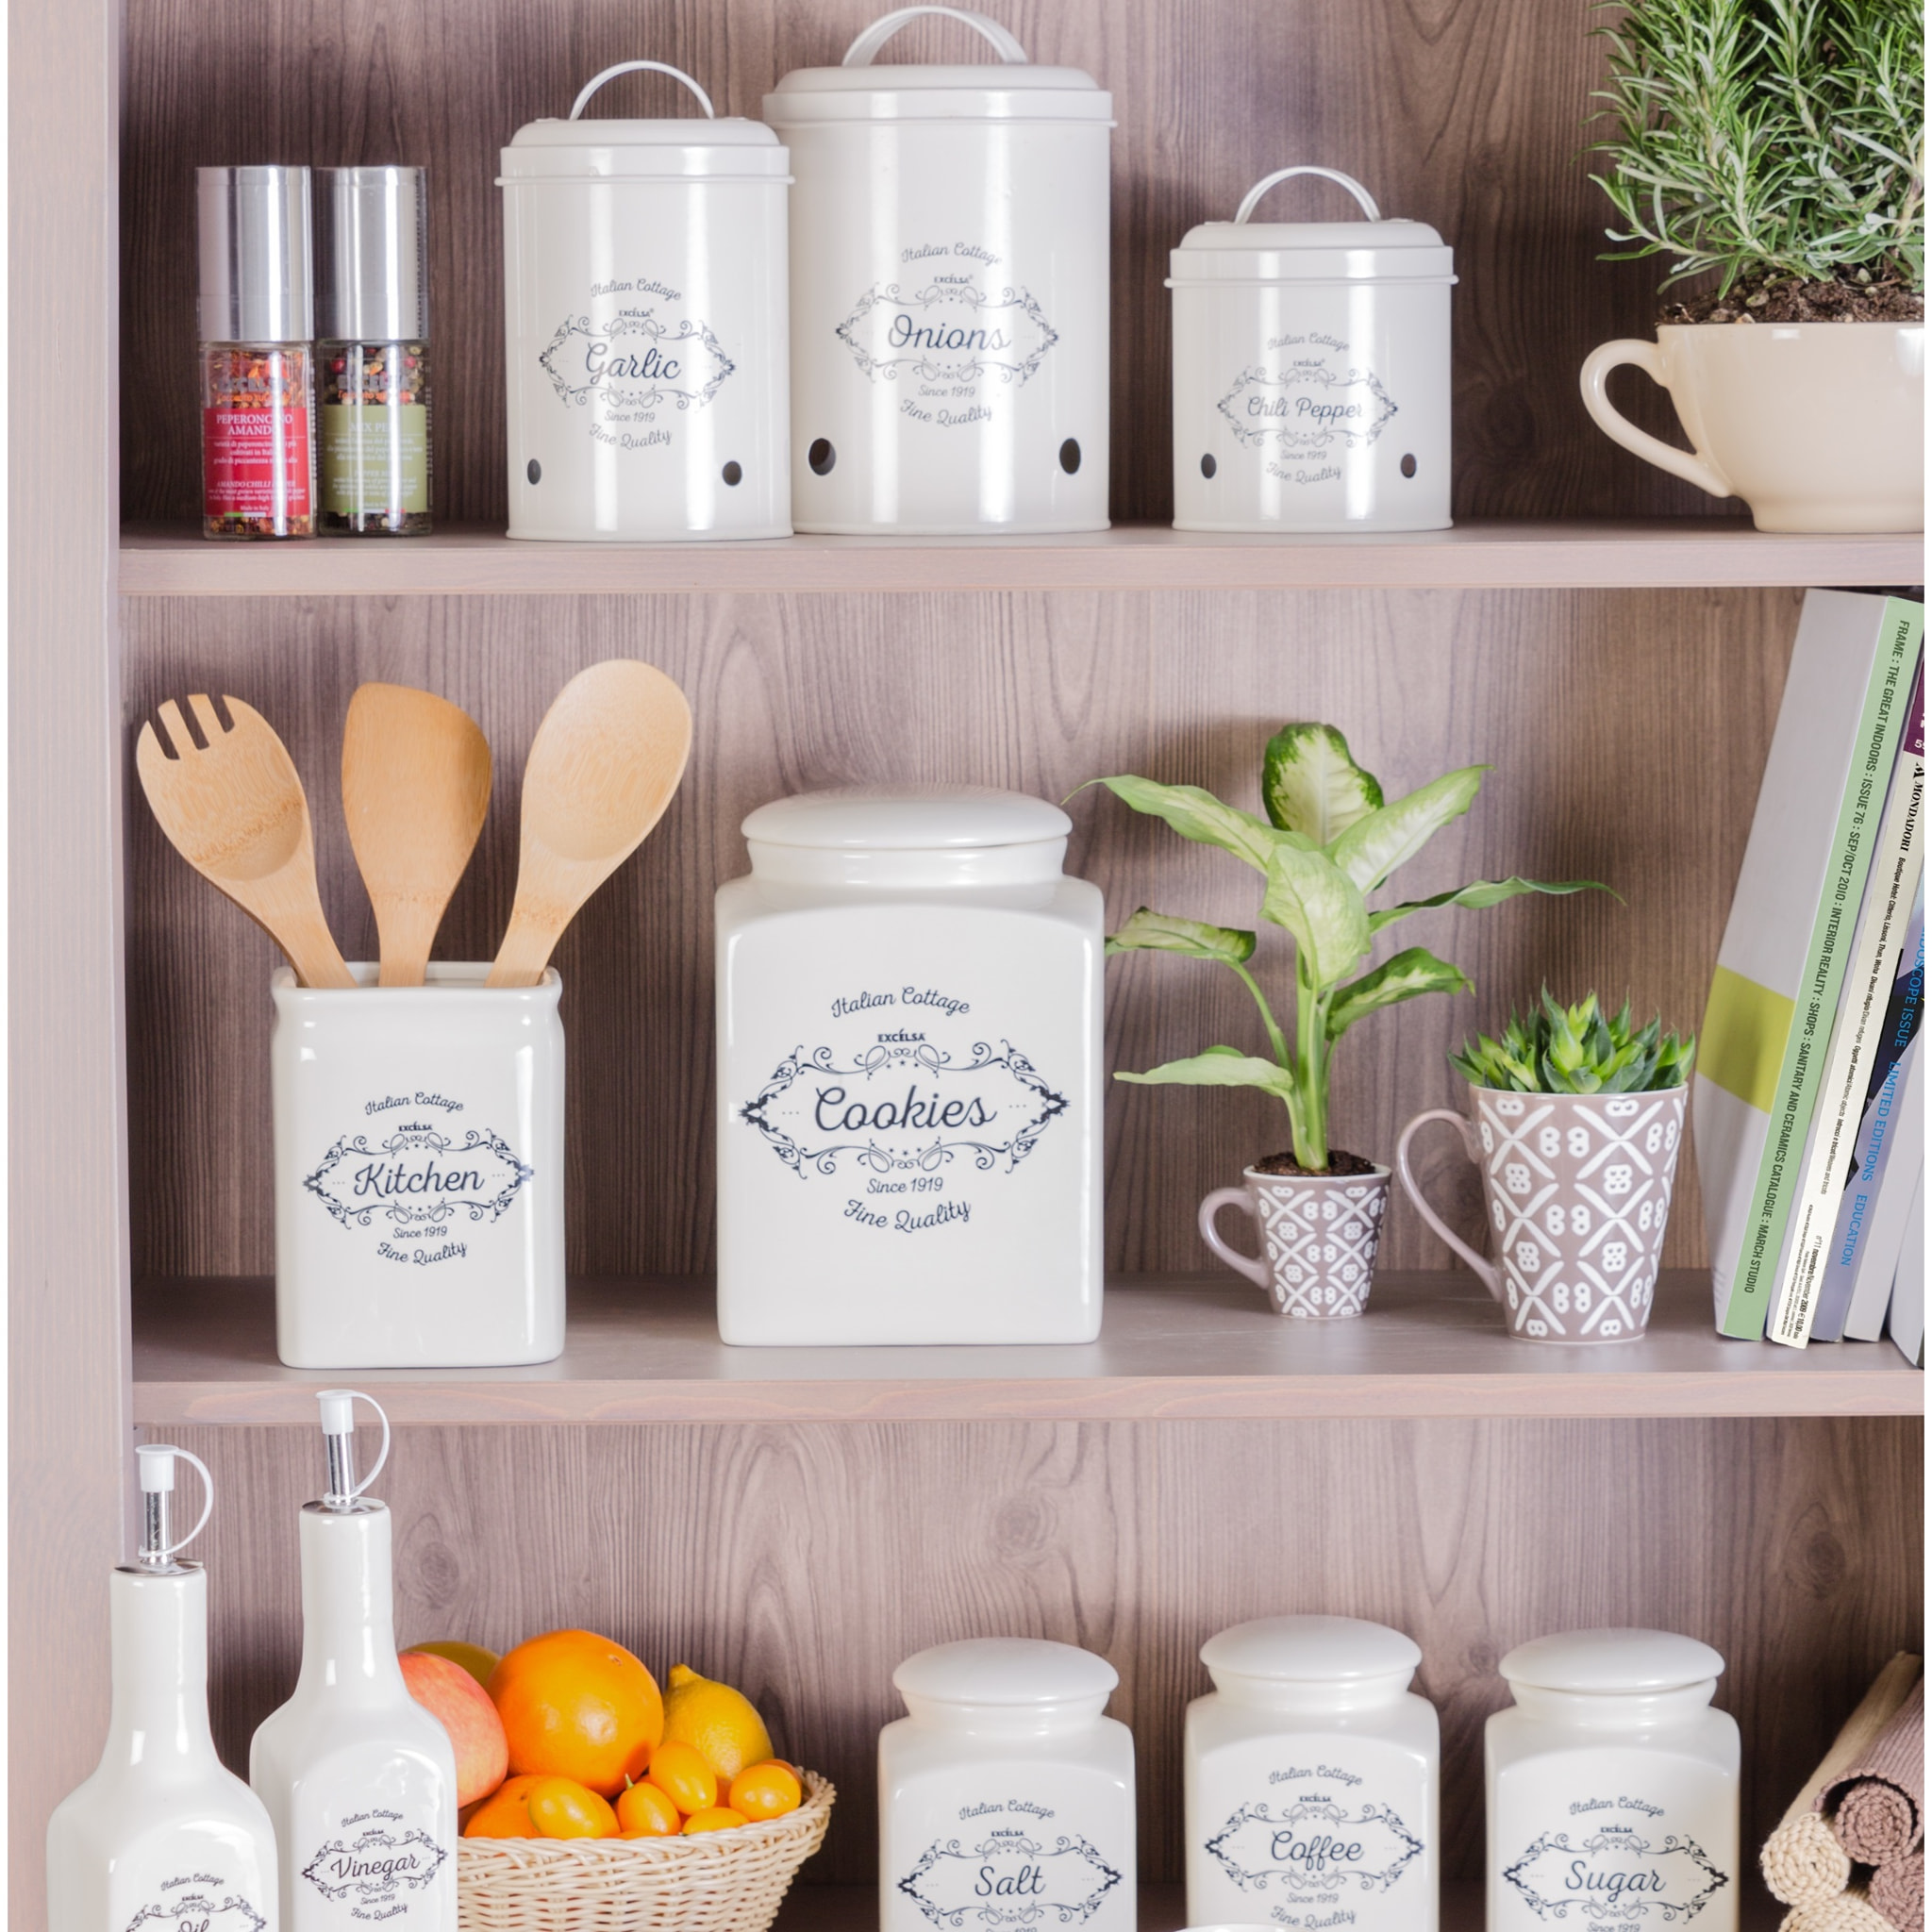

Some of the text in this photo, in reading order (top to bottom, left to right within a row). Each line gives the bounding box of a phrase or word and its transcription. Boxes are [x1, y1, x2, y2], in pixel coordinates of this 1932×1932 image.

[902, 242, 1002, 266] Italian Cottage
[591, 278, 681, 301] Italian Cottage
[889, 314, 1011, 350] Onions
[1268, 332, 1349, 352] Italian Cottage
[586, 342, 681, 385] Garlic
[918, 385, 975, 397] Since 1919
[217, 413, 292, 425] PEPERONCO
[605, 410, 655, 423] Since 1919
[900, 399, 992, 426] Fine Quality
[1247, 396, 1363, 425] Chili Pepper
[228, 425, 280, 435] AMAND
[590, 424, 672, 450] Fine Quality
[1280, 450, 1326, 460] Since 1919
[1266, 462, 1341, 485] Fine Quality
[1892, 620, 1910, 658] FRAME
[1885, 665, 1900, 687] THE
[1877, 688, 1894, 723] GREAT
[1865, 723, 1886, 773] INDOORS
[1857, 778, 1873, 810] ISSUE
[1853, 810, 1865, 824] 76
[1900, 781, 1924, 852] MONDADORI
[1840, 831, 1860, 876] SEP/OCT
[1892, 857, 1906, 883] Boutique
[1835, 876, 1850, 901] 2010
[1822, 907, 1842, 955] INTERIOR
[1812, 955, 1831, 996] REALITY
[831, 987, 970, 1018] Italian Cottage
[1803, 1002, 1820, 1037] SHOPS
[1893, 1008, 1915, 1049] ISSUE
[877, 1029, 925, 1042] EXCÉLSA
[1790, 1041, 1810, 1091] SANITARY
[1786, 1091, 1800, 1112] AND
[1876, 1061, 1901, 1118] LIMITED
[365, 1092, 464, 1115] Italian Cottage
[815, 1085, 997, 1132] Cookies
[1774, 1112, 1795, 1163] CERAMICS
[1860, 1120, 1887, 1183] EDITIONS
[354, 1160, 485, 1198] Kitchen
[867, 1177, 943, 1194] Since 1919
[1761, 1163, 1783, 1218] CATALOGUE
[843, 1199, 972, 1233] Fine Quality
[392, 1226, 447, 1238] Since 1919
[1751, 1224, 1769, 1258] MARCH
[1839, 1193, 1868, 1267] EDUCATION
[377, 1241, 467, 1265] Fine Quality
[1743, 1259, 1760, 1293] STUDIO
[1799, 1299, 1808, 1313] 2009
[1269, 1765, 1362, 1787] Italian Cottage
[341, 1809, 404, 1827] Italian Cottage
[958, 1800, 1055, 1820] Italian Cottage
[1570, 1796, 1664, 1817] Italian Cottage
[1272, 1830, 1364, 1871] Coffee
[330, 1854, 420, 1880] Vinegar
[160, 1874, 225, 1890] Italian Cottage
[975, 1865, 1045, 1896] Salt
[1565, 1860, 1666, 1902] Sugar
[360, 1896, 379, 1906] Since
[1287, 1892, 1339, 1904] Since 1919
[351, 1904, 408, 1921] Fine Quality
[1271, 1906, 1357, 1930] Fine Quality
[1587, 1923, 1640, 1932] Since 1919
